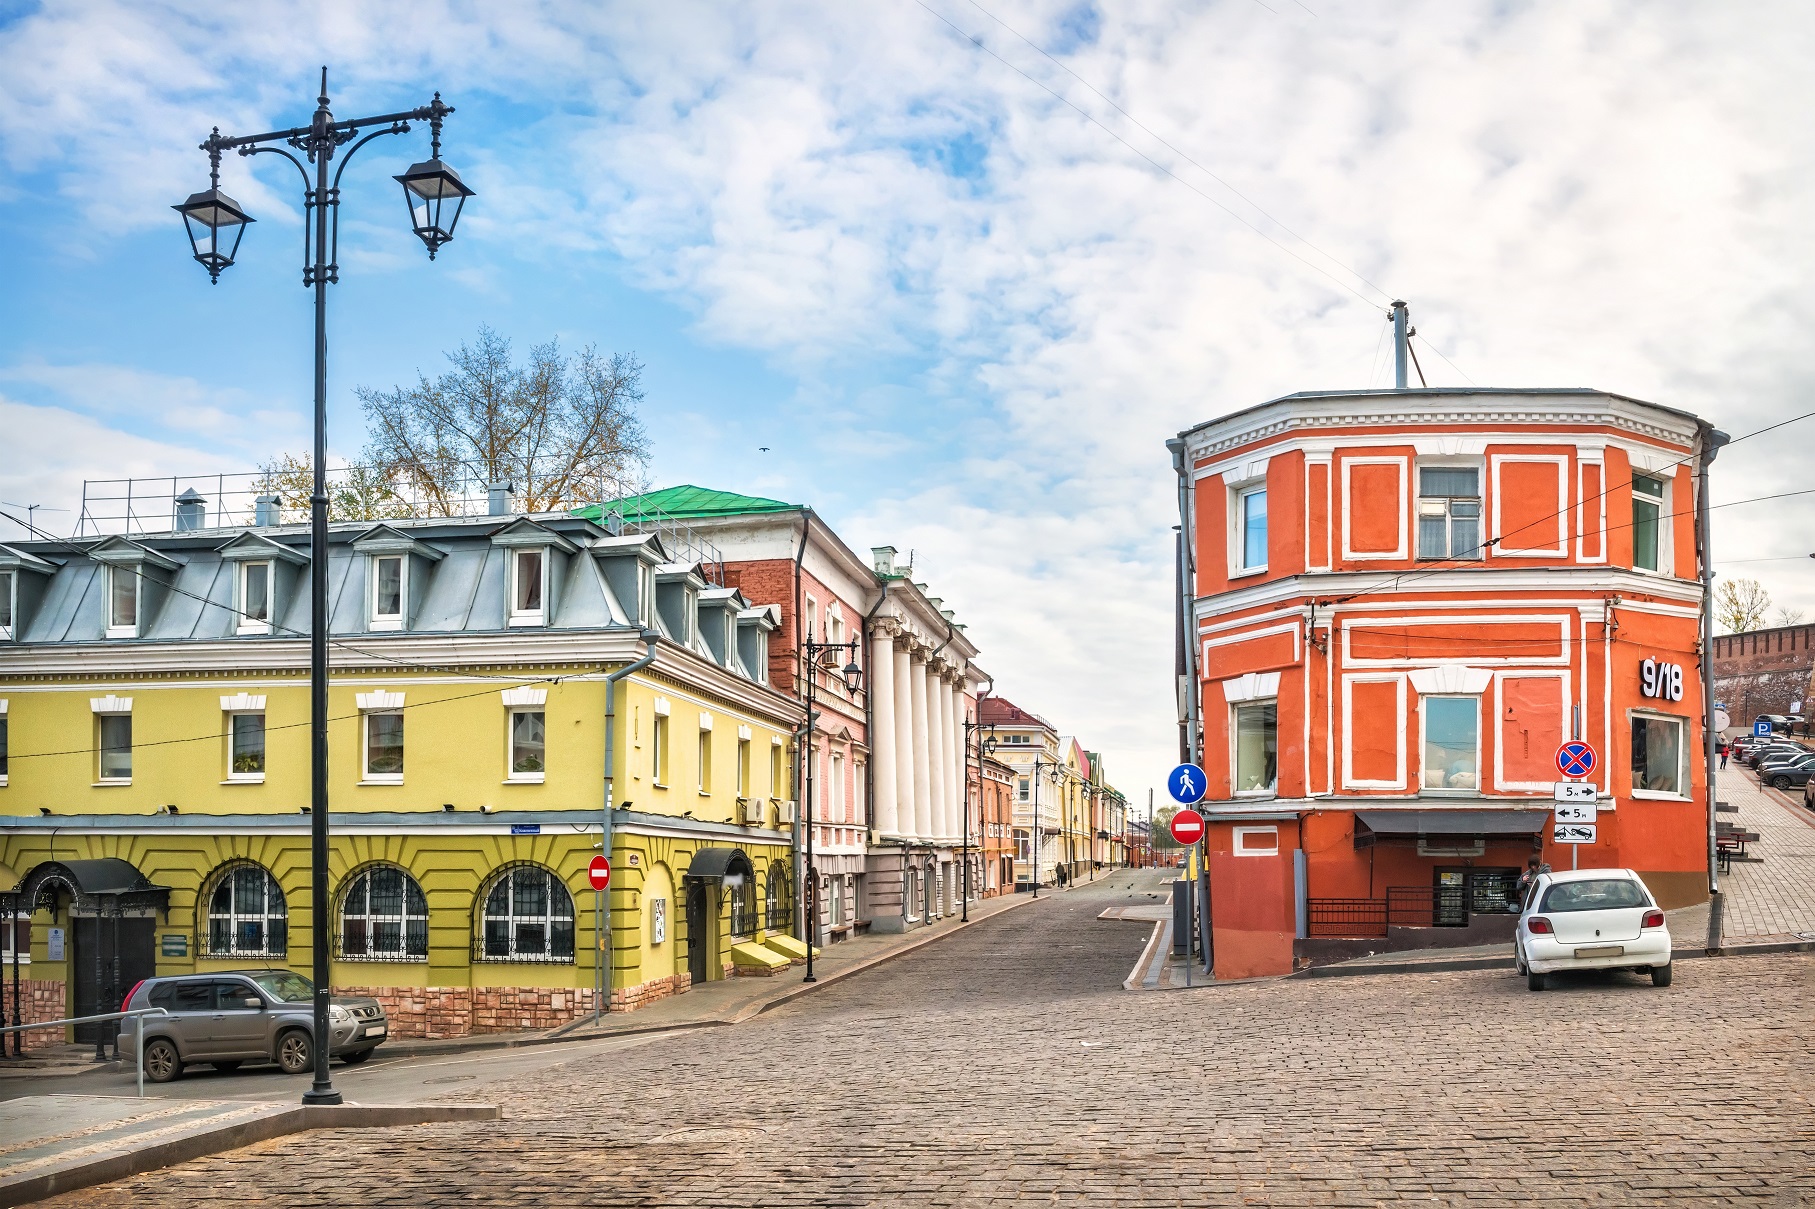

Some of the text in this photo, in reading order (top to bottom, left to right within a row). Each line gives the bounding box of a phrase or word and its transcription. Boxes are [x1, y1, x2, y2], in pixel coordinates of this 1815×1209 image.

[1642, 658, 1684, 702] 9/18
[1758, 723, 1768, 735] P
[1566, 786, 1573, 796] 5
[1574, 808, 1580, 818] 5
